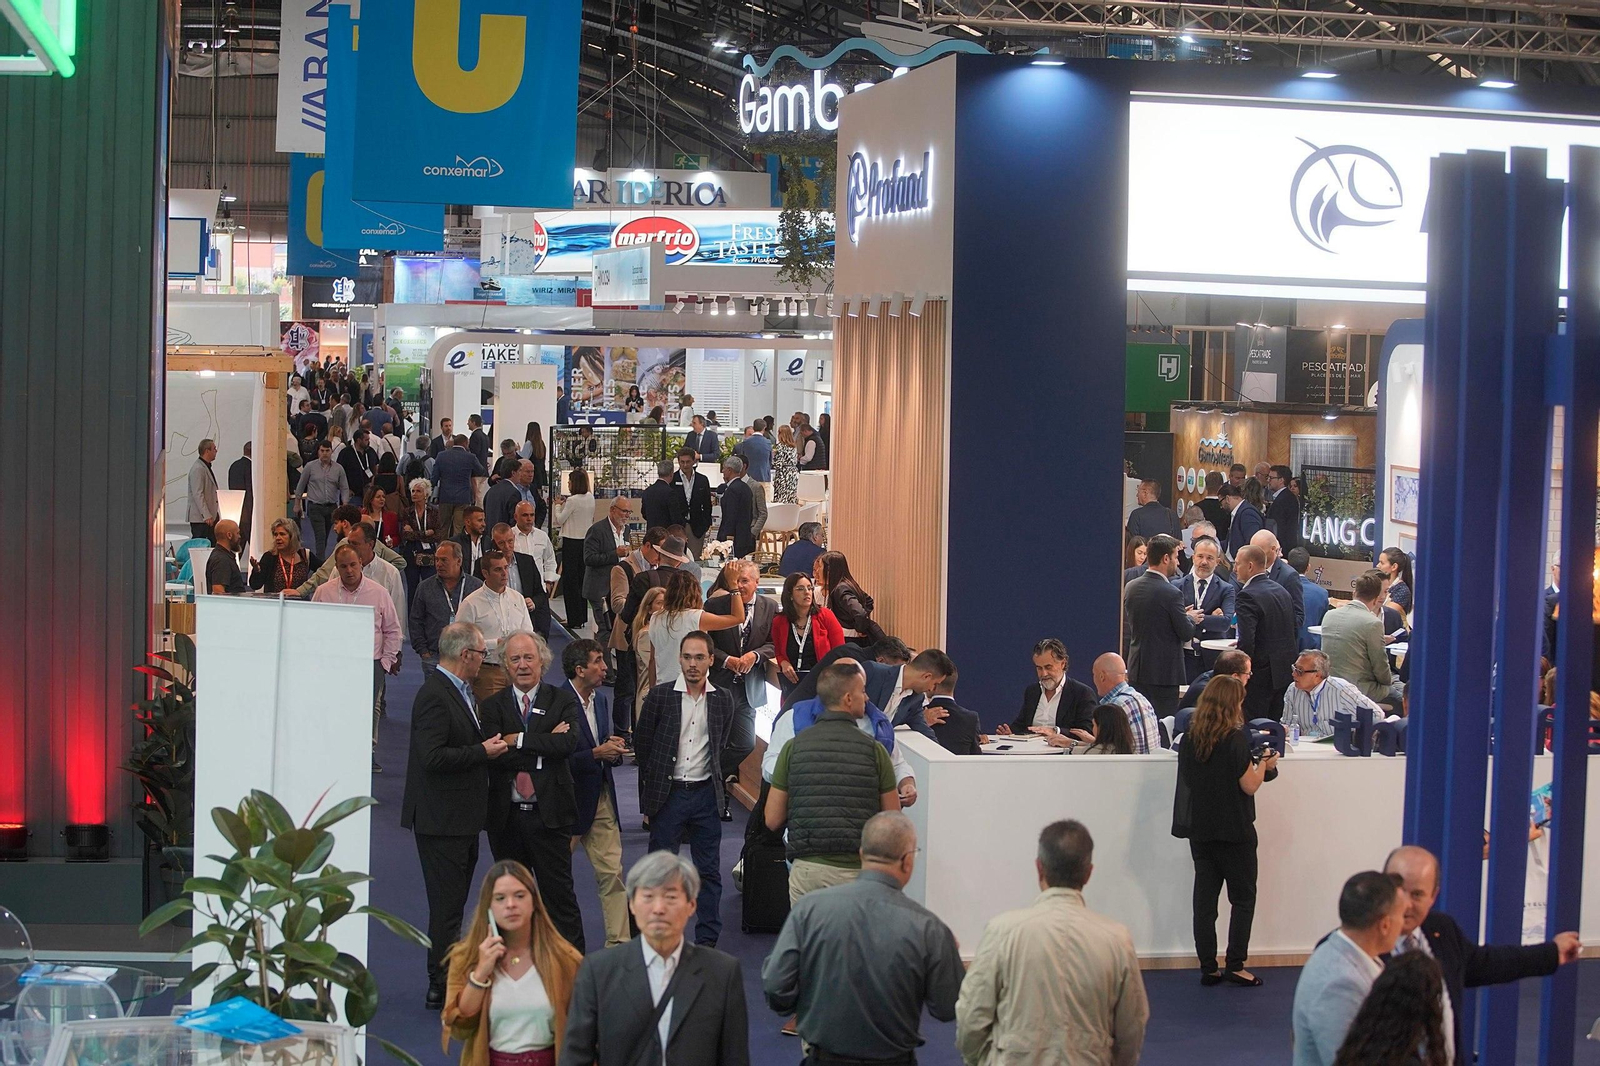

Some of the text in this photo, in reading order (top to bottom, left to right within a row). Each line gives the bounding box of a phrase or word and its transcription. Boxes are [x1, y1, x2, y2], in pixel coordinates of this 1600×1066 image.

[740, 67, 910, 134] Gamb
[423, 166, 488, 178] conxemar
[867, 149, 931, 217] Profand
[617, 229, 694, 246] marfrío
[714, 241, 770, 258] TASTE
[482, 348, 519, 361] AKE
[1302, 362, 1367, 372] PESCATRAD
